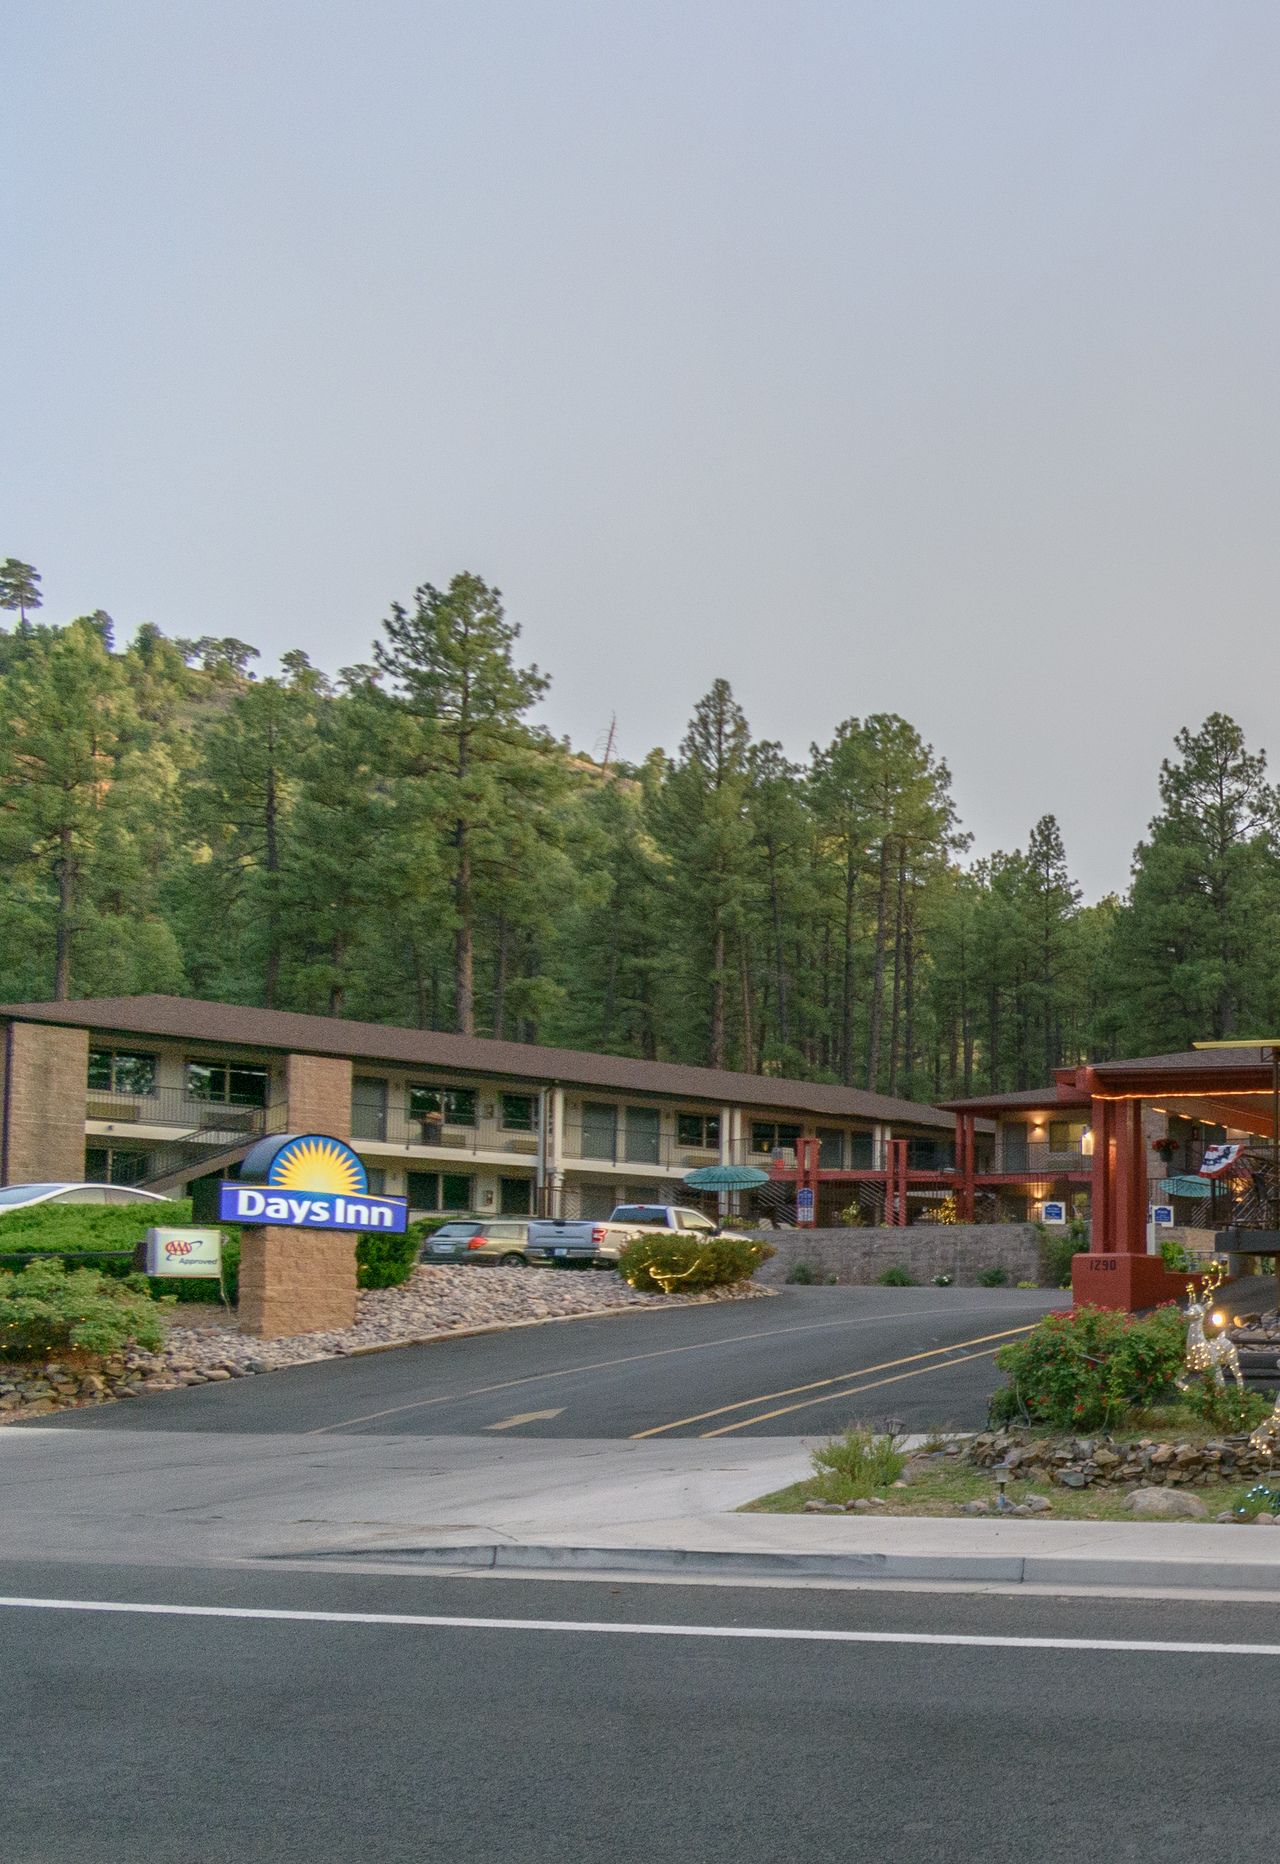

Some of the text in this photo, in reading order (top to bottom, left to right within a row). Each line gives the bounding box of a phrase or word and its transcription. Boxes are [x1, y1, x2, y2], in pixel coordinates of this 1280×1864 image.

[237, 1189, 393, 1227] Days Inn
[166, 1240, 192, 1256] AAA
[179, 1258, 218, 1268] Approved
[1090, 1259, 1117, 1271] 1290
